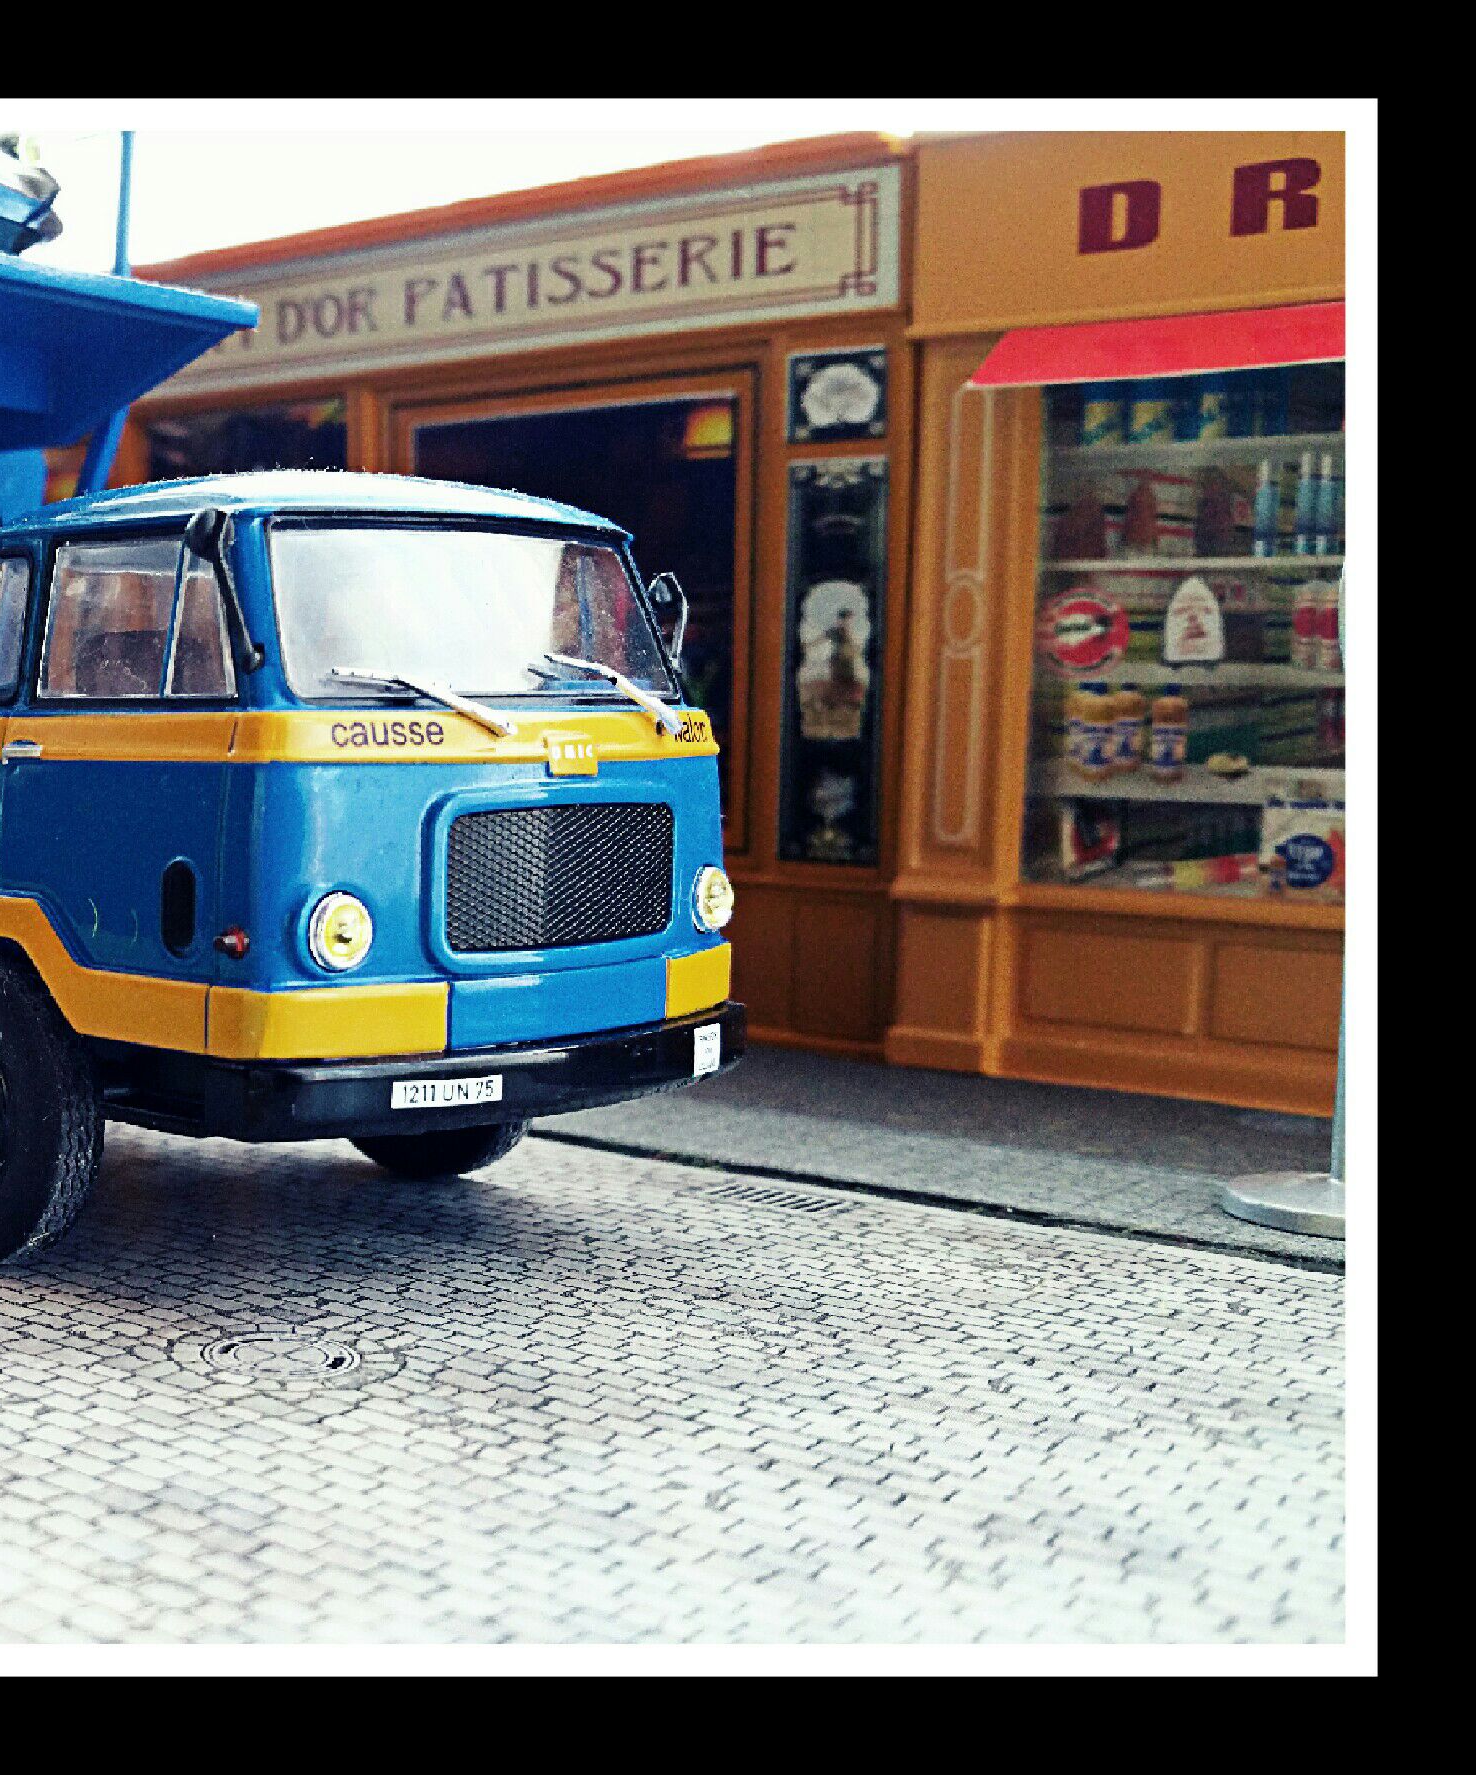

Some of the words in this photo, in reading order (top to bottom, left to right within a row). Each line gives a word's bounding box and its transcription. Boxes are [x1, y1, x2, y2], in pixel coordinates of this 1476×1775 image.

[277, 284, 377, 346] D'OR
[404, 222, 799, 326] PATISSERIE
[331, 719, 445, 748] causse
[402, 1083, 436, 1104] 1211
[442, 1082, 470, 1102] UN
[475, 1079, 495, 1100] 75
